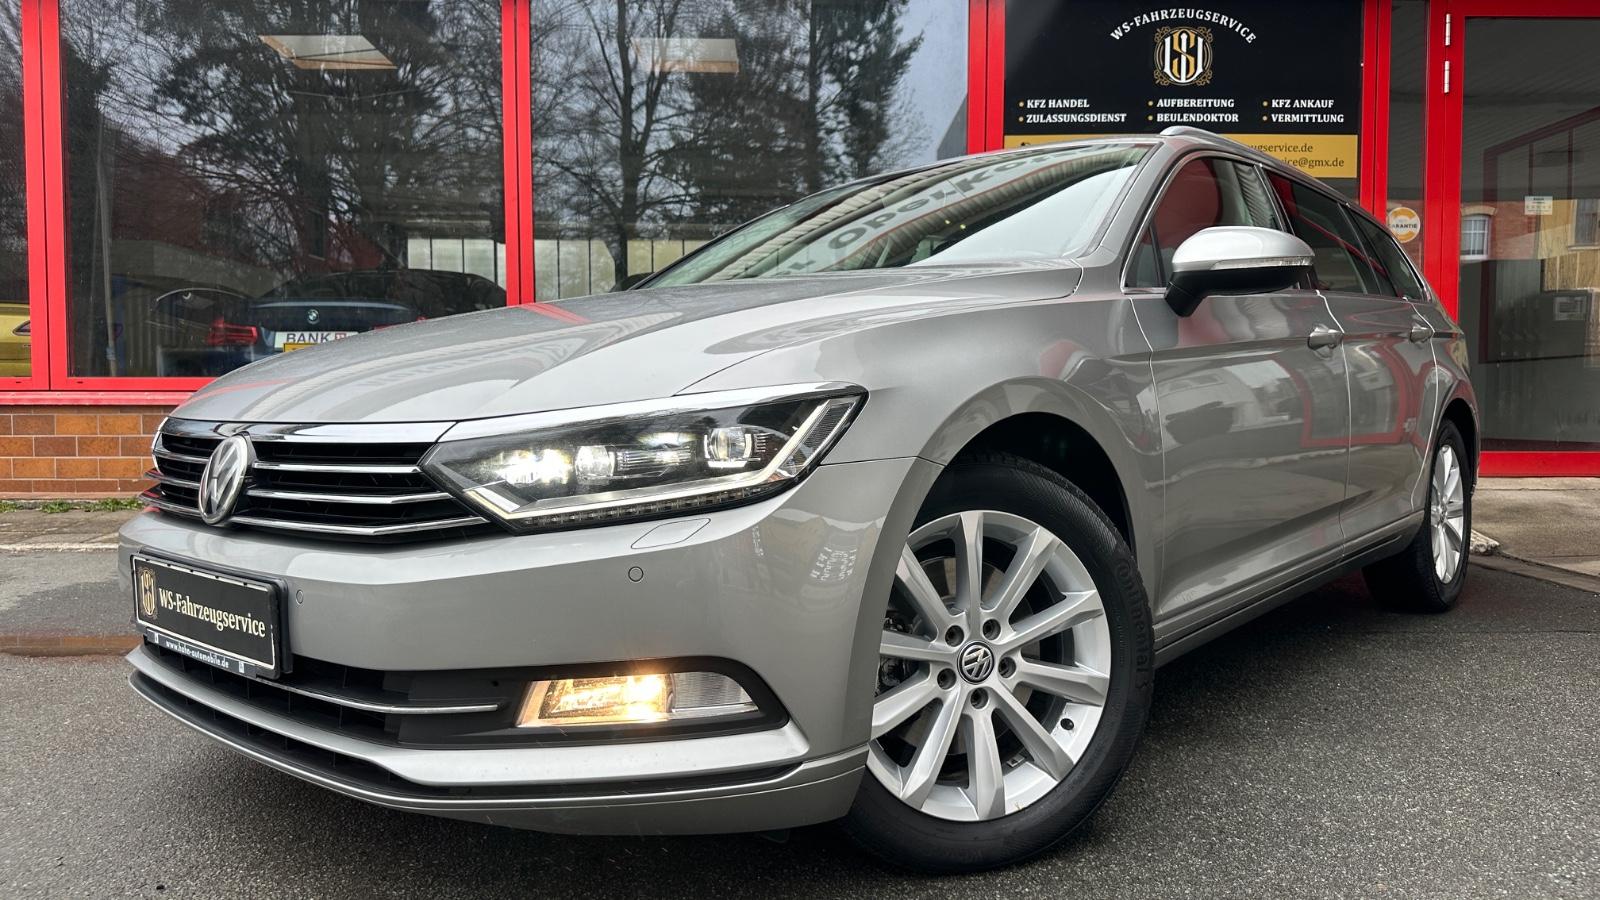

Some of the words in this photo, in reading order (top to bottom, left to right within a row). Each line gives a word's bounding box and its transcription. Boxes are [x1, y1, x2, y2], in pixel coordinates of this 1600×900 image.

[1110, 8, 1257, 44] WS-FAHRZEUGSERVICE
[1027, 99, 1046, 109] KFZ
[1048, 99, 1090, 108] HANDEL
[1156, 98, 1235, 108] AUFBEREITUNG
[1271, 99, 1291, 109] KFZ
[1293, 99, 1335, 109] ANKAUF
[1026, 113, 1127, 123] ZULASSUNGSDIENST
[1156, 113, 1239, 123] BEULENDOKTOR
[1271, 113, 1345, 124] VERMITTLUNG
[286, 333, 331, 343] BANK
[158, 587, 266, 638] WS-Fahrzeugservice
